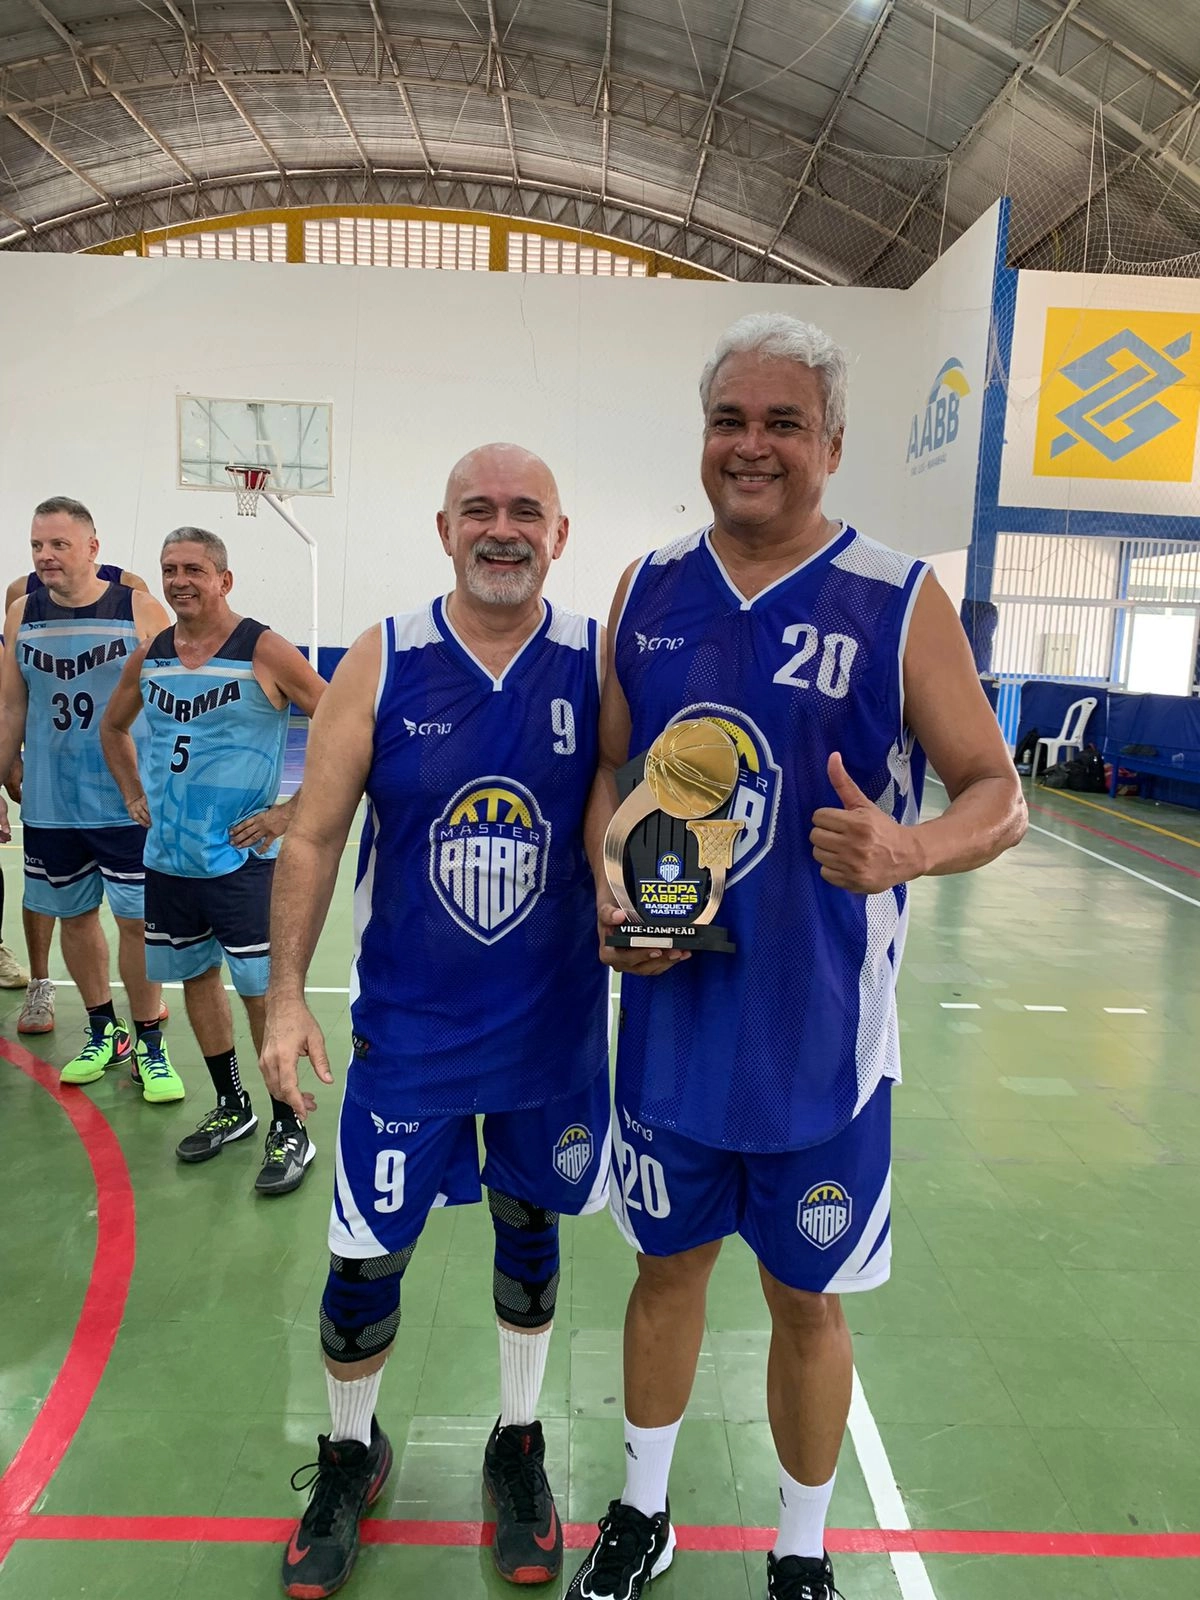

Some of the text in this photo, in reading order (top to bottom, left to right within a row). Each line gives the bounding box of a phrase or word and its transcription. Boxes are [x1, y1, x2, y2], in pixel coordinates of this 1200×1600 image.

[906, 391, 960, 463] AABB
[21, 638, 128, 681] TURMA
[773, 623, 858, 699] 20
[51, 691, 94, 732] 39
[147, 679, 241, 724] TURMA
[551, 697, 577, 755] 9
[170, 735, 191, 774] 5
[440, 823, 541, 843] MASTER
[641, 884, 697, 894] IX COPA
[373, 1149, 407, 1213] 9
[622, 1140, 671, 1218] 20
